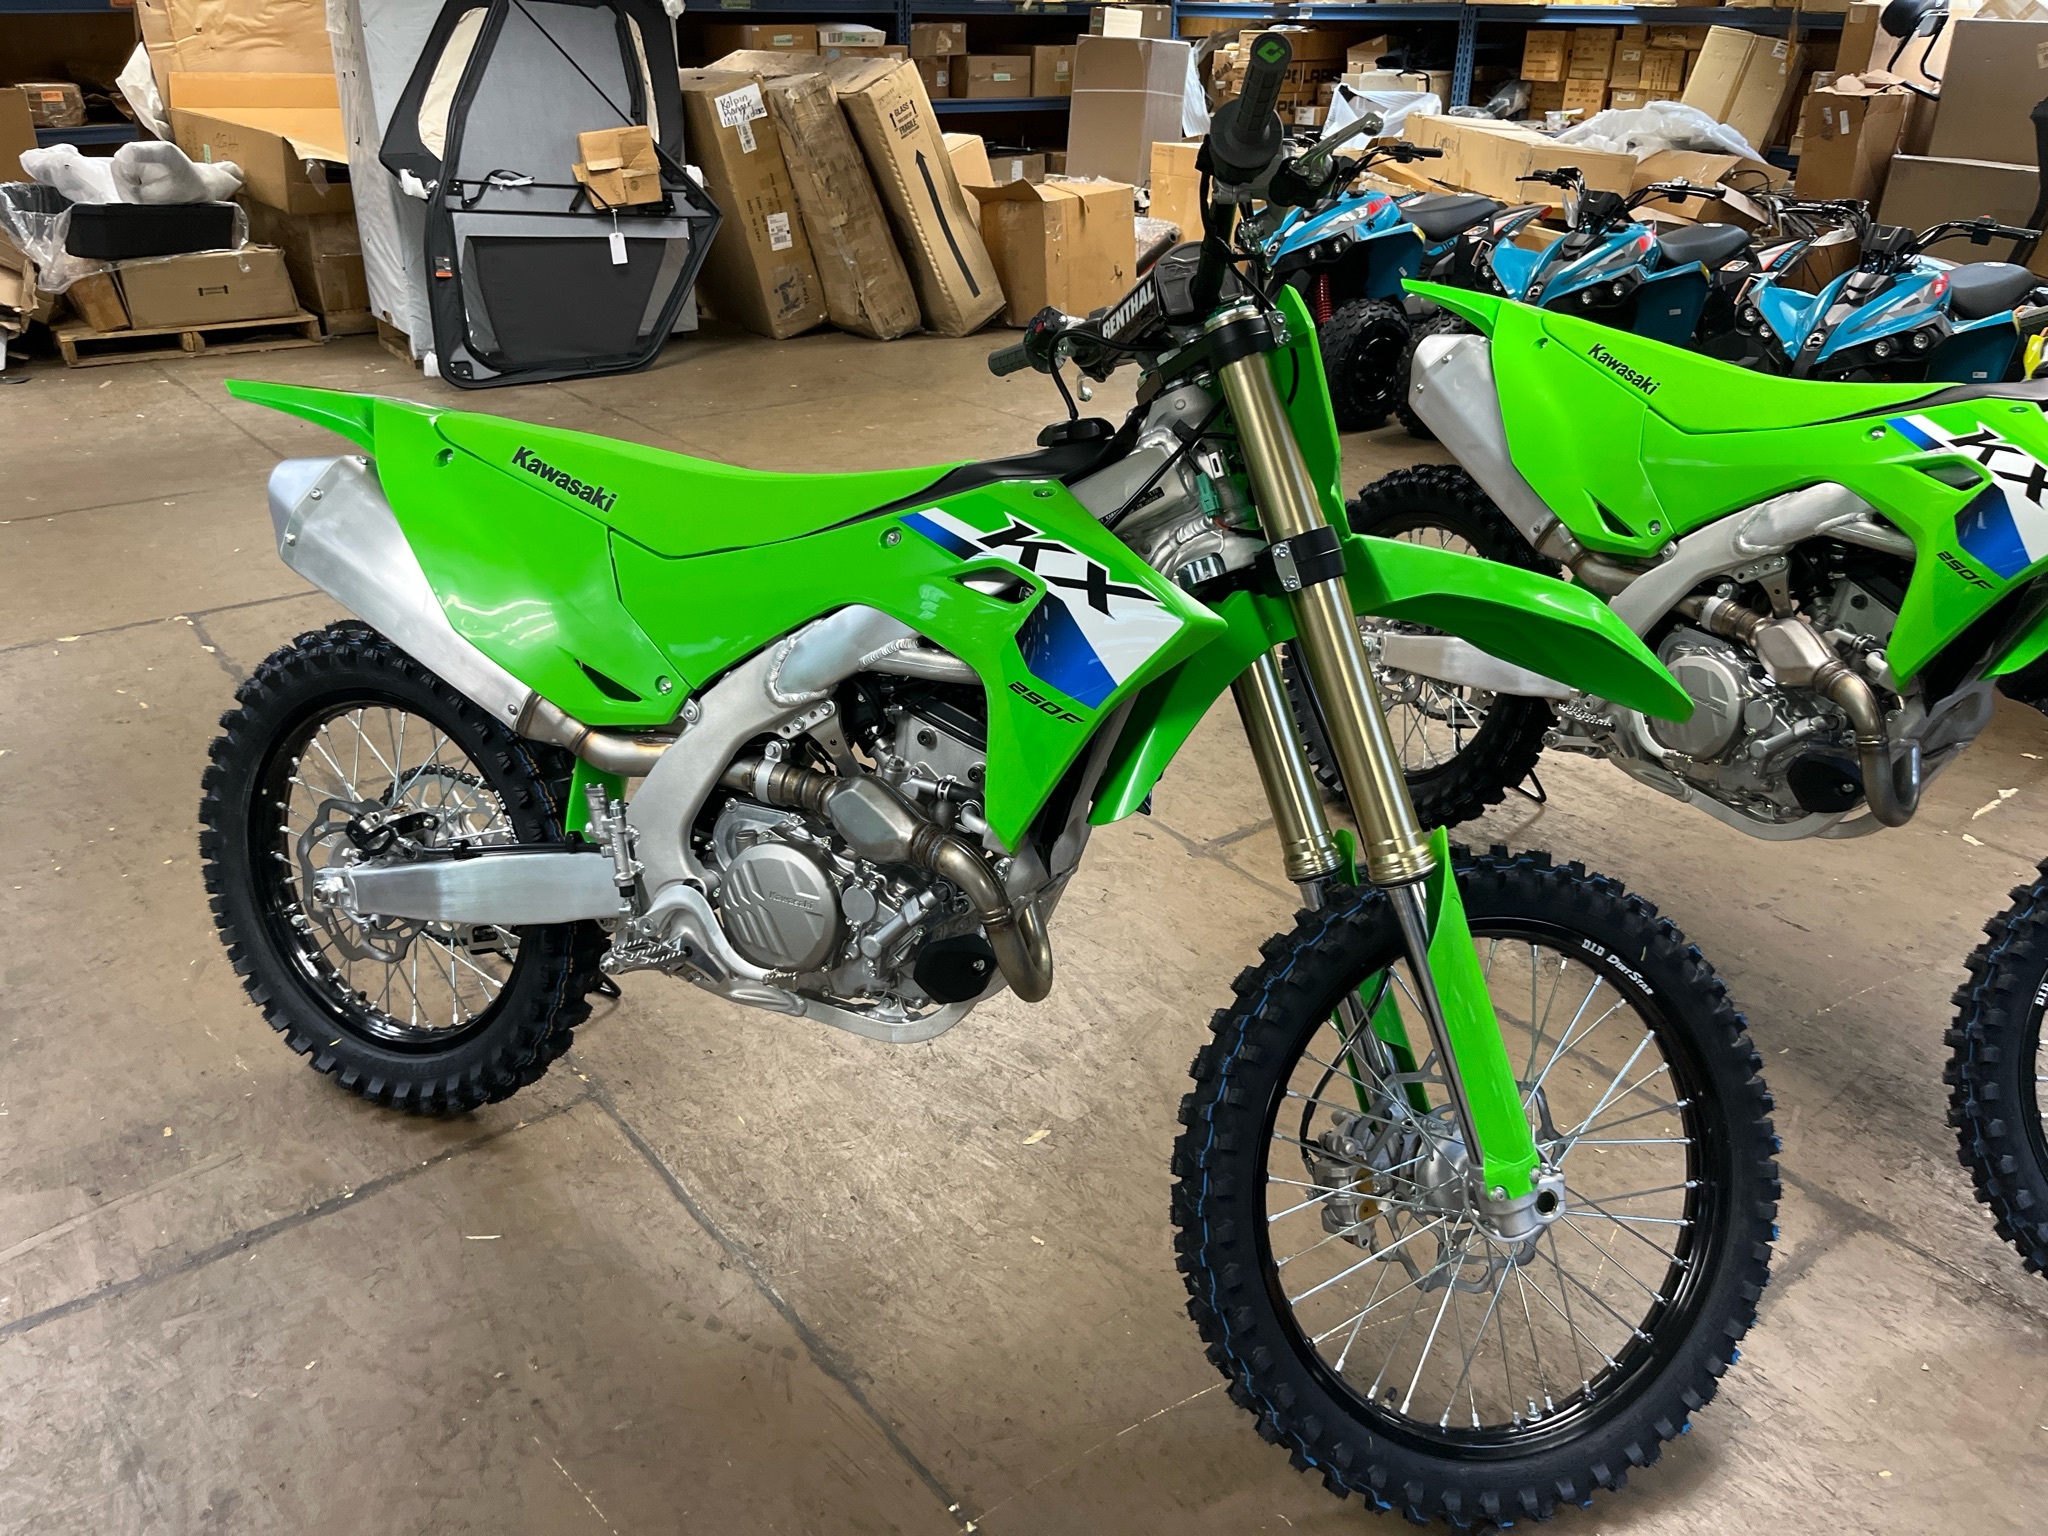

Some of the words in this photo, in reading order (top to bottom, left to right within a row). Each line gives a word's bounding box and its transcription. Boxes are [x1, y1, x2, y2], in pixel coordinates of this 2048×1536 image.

[720, 94, 748, 109] Kolpin
[894, 102, 909, 117] GLASS
[899, 118, 917, 135] FRAGILE
[1102, 280, 1155, 339] RENTHAL
[1587, 343, 1661, 396] Kawasaki
[511, 446, 618, 513] Kawasaki
[1946, 427, 2048, 511] KX
[976, 519, 1161, 620] KX
[1936, 551, 1995, 590] 250F
[1008, 681, 1085, 724] 250F
[769, 891, 813, 910] Kawasaki
[1581, 938, 1606, 957] DID
